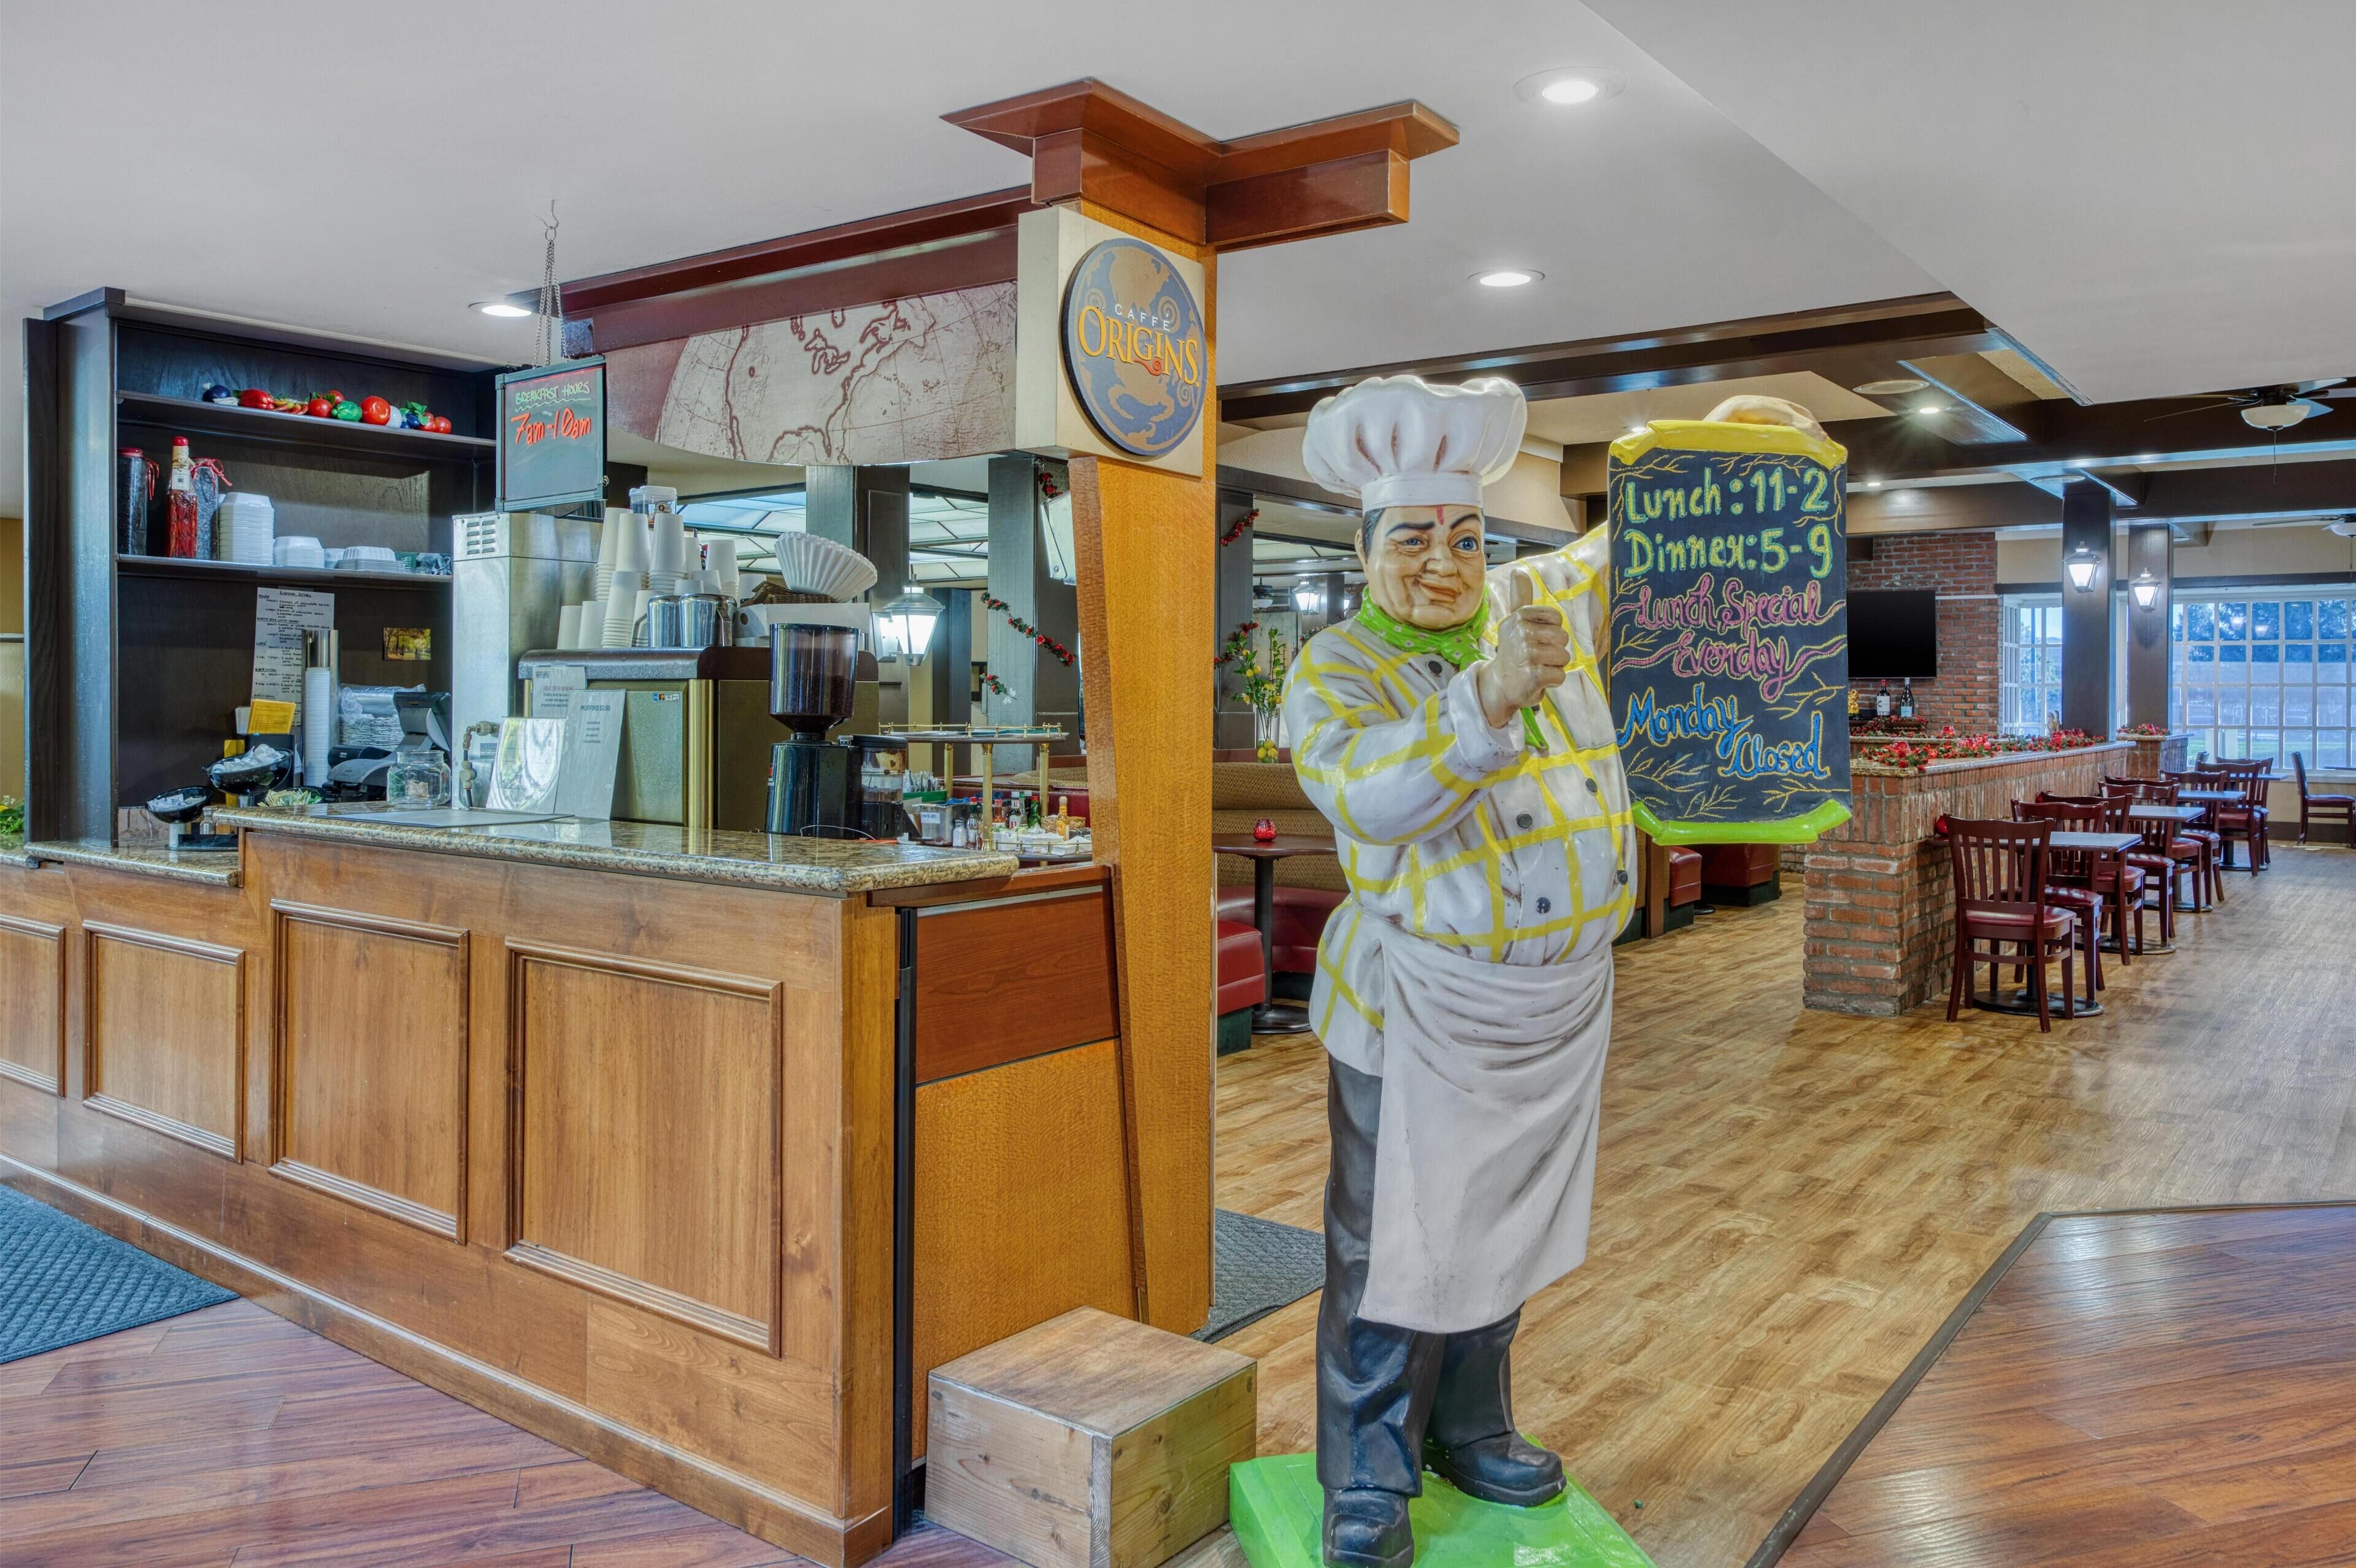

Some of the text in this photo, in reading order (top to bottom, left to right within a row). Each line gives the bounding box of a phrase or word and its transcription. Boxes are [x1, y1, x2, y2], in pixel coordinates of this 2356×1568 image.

[1078, 304, 1199, 386] ORIGINS
[1114, 304, 1171, 332] CAFFÉ
[515, 381, 590, 405] BREAKFAST HOURS
[1750, 466, 1830, 514] 11-2
[1633, 572, 1823, 640] Lunch Special
[1615, 682, 1754, 759] Monday
[1717, 710, 1831, 779] Closed
